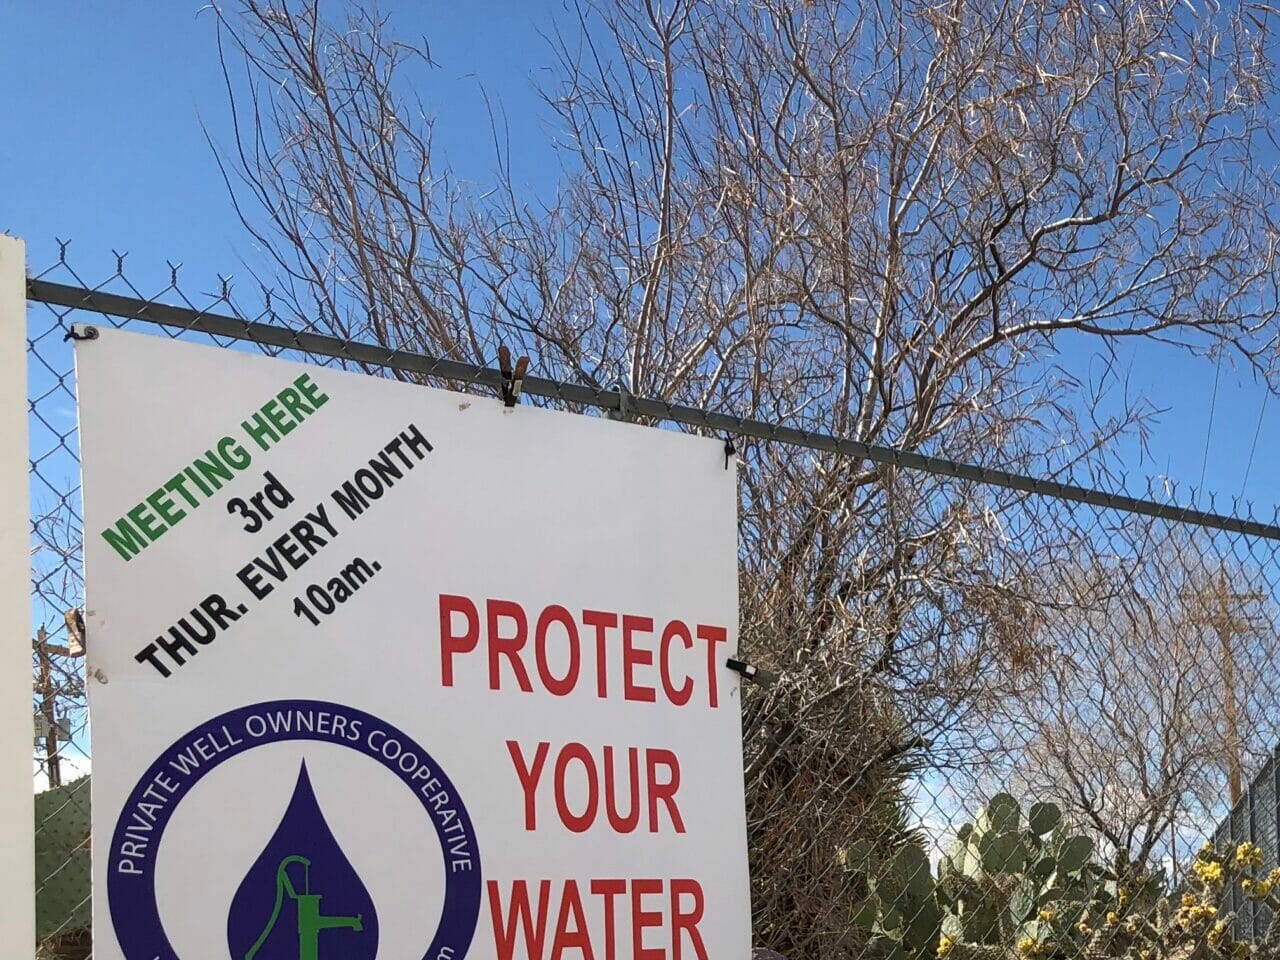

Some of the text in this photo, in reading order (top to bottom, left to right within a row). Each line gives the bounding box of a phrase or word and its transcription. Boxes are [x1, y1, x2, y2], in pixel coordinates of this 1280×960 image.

[101, 372, 330, 562] MEETING HERE
[226, 470, 295, 534] 3rd
[135, 424, 434, 679] THUR. EVERY MONTH
[293, 555, 382, 627] 10am.
[438, 594, 727, 708] PROTECT
[118, 710, 472, 875] PRIVATE WELL OWNERS COOPERATIVE
[506, 740, 686, 834] YOUR
